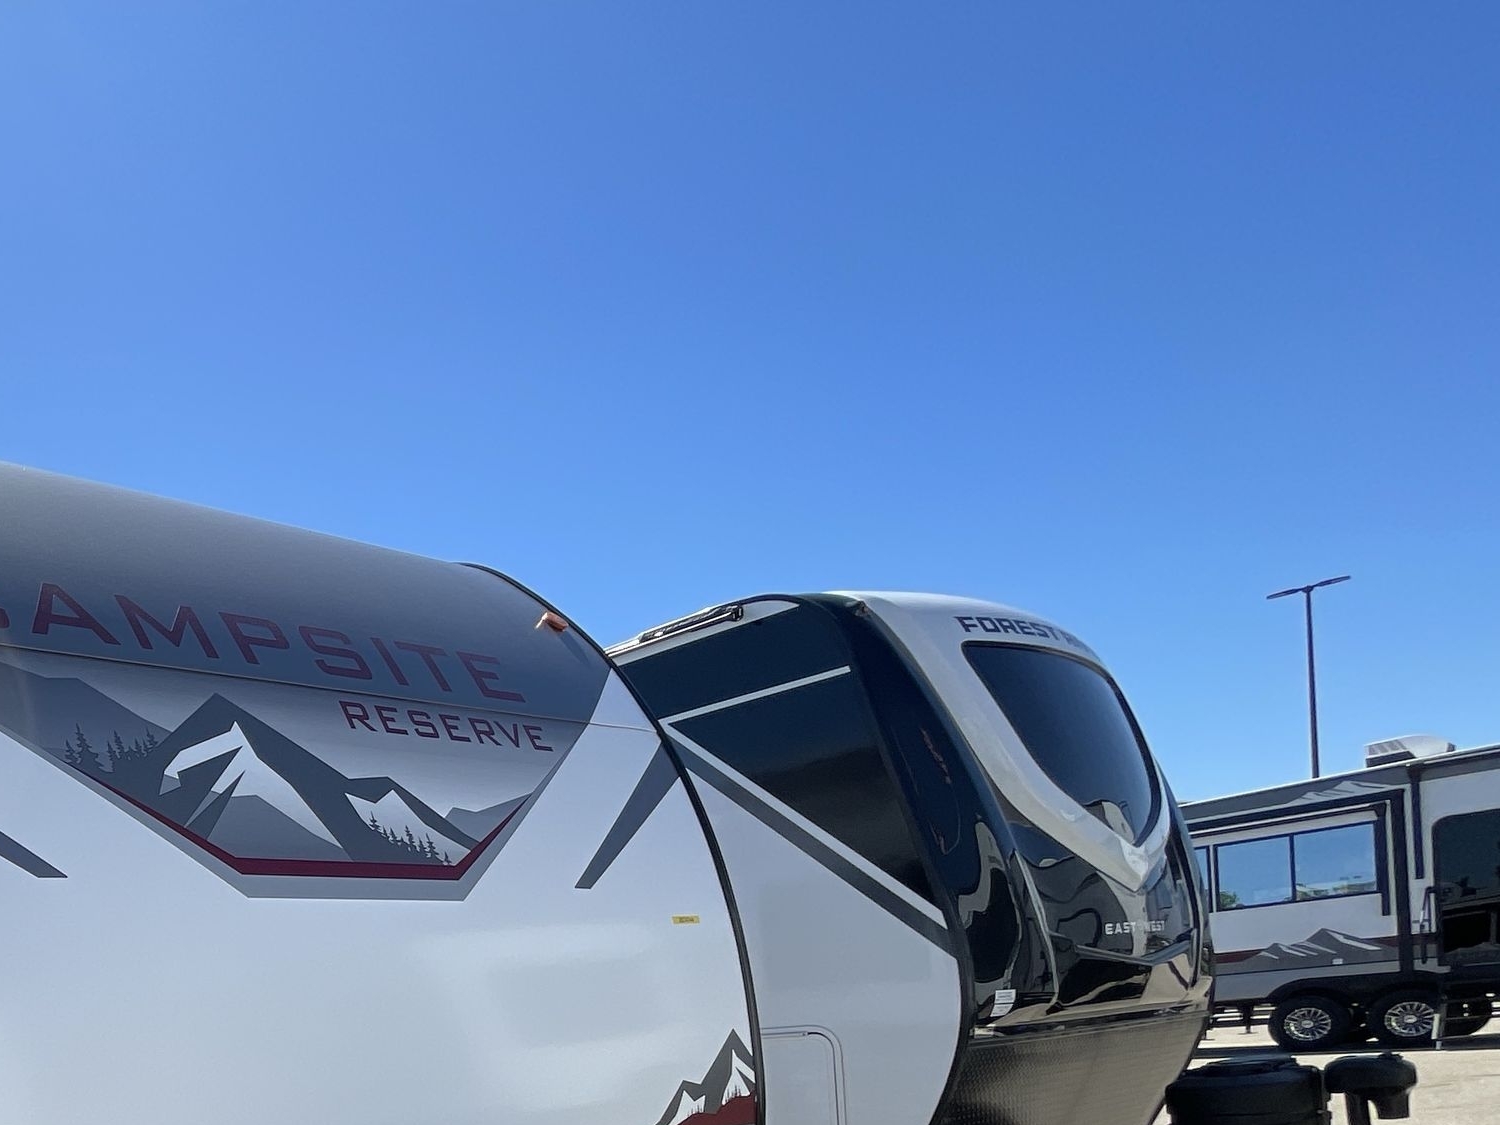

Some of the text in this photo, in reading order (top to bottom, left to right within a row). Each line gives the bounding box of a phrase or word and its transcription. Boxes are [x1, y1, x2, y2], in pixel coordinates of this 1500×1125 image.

[954, 616, 1060, 641] FOREST
[339, 700, 554, 752] RESERVE
[1104, 921, 1136, 935] EAST
